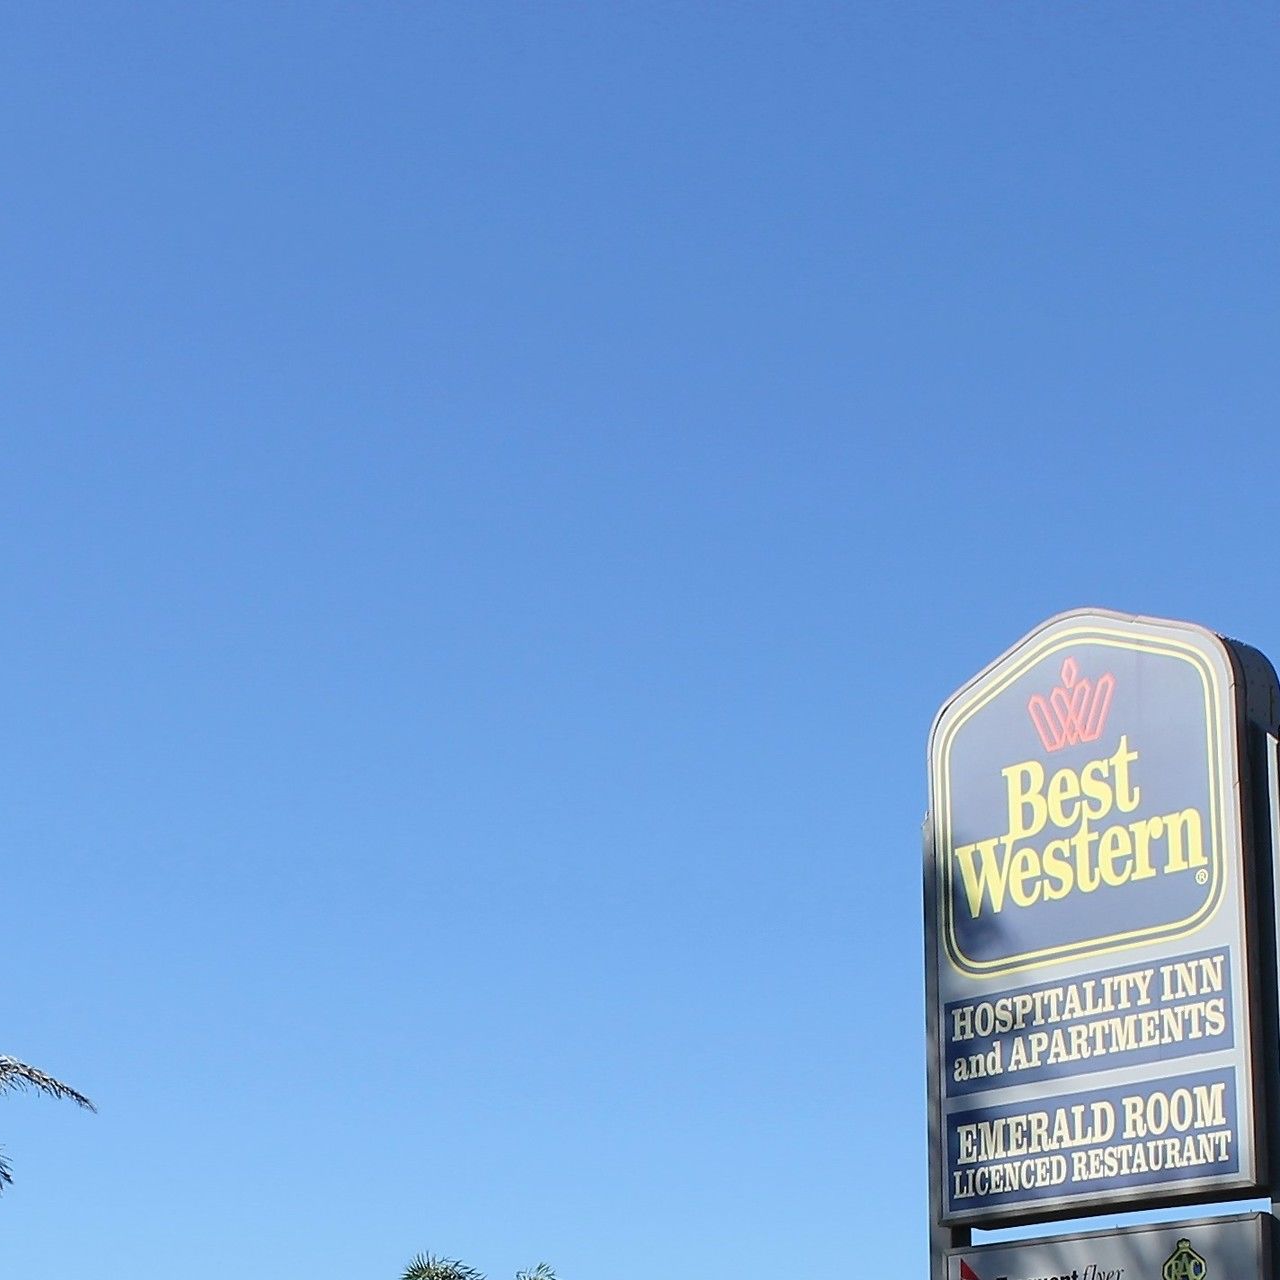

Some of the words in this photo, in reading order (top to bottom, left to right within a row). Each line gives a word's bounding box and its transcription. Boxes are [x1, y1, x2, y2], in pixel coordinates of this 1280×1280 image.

[1001, 734, 1140, 840] Best
[954, 806, 1208, 920] Western
[951, 969, 1153, 1043] HOSPITALITY
[1160, 955, 1225, 1001] INN
[953, 1046, 1004, 1082] and
[1007, 998, 1226, 1072] APARTMENTS
[953, 1154, 1068, 1199] LICENCED
[1070, 1130, 1232, 1183] RESTAURANT
[956, 1100, 1116, 1166] EMERALD
[1122, 1082, 1226, 1140] ROOM
